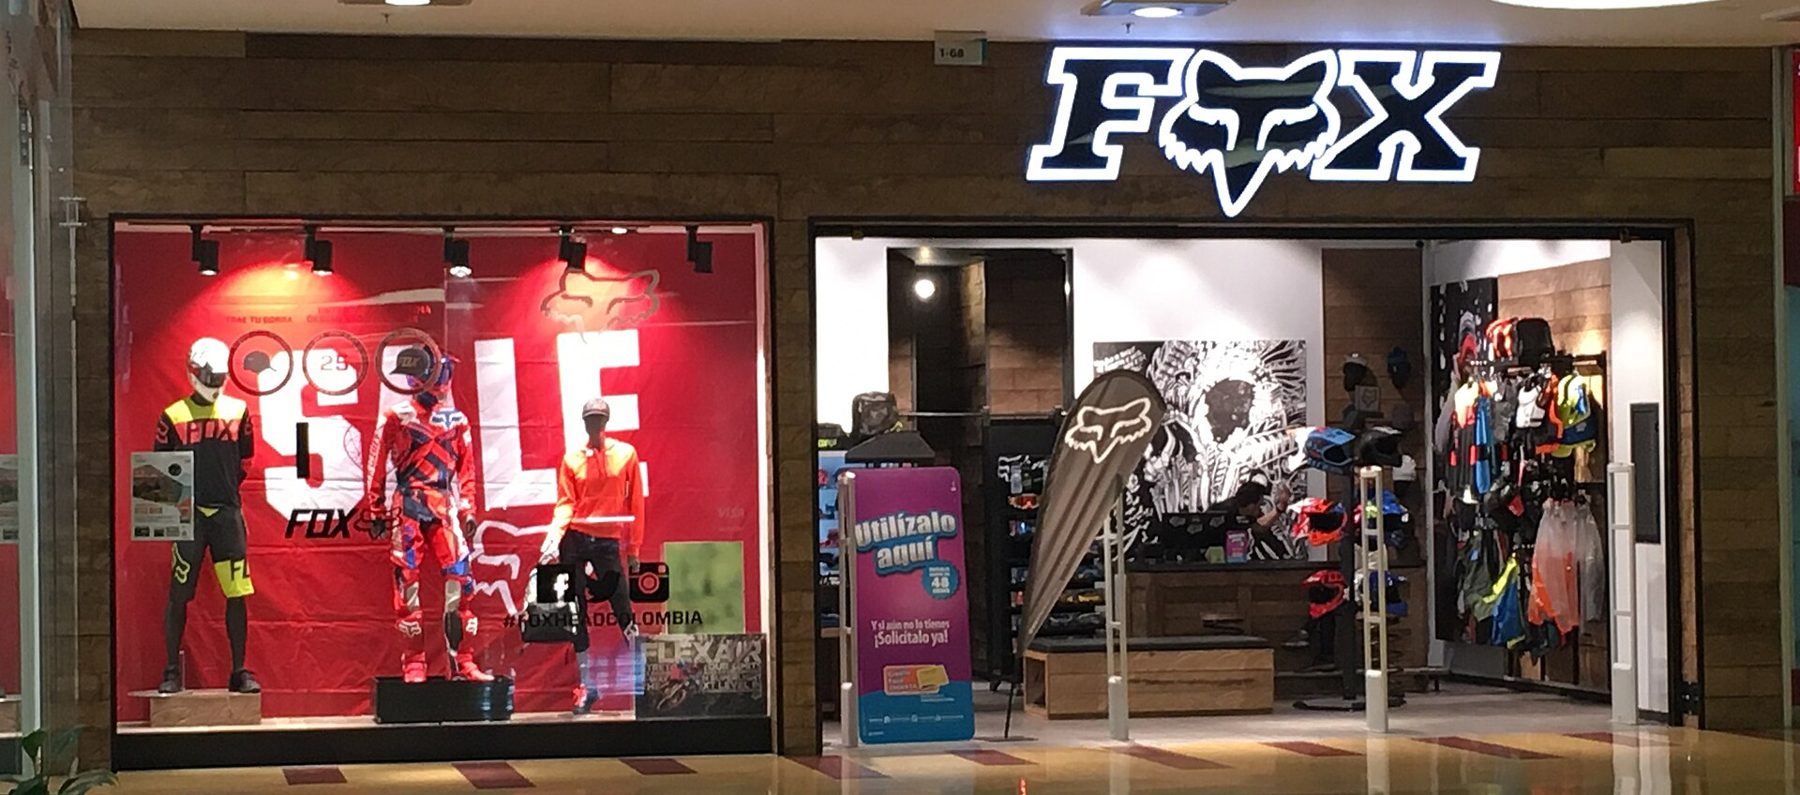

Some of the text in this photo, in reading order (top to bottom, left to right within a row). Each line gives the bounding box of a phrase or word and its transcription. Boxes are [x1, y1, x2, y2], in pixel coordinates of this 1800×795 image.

[285, 508, 358, 538] FOX
[855, 511, 956, 547] Utilízalo
[877, 535, 934, 568] aquí
